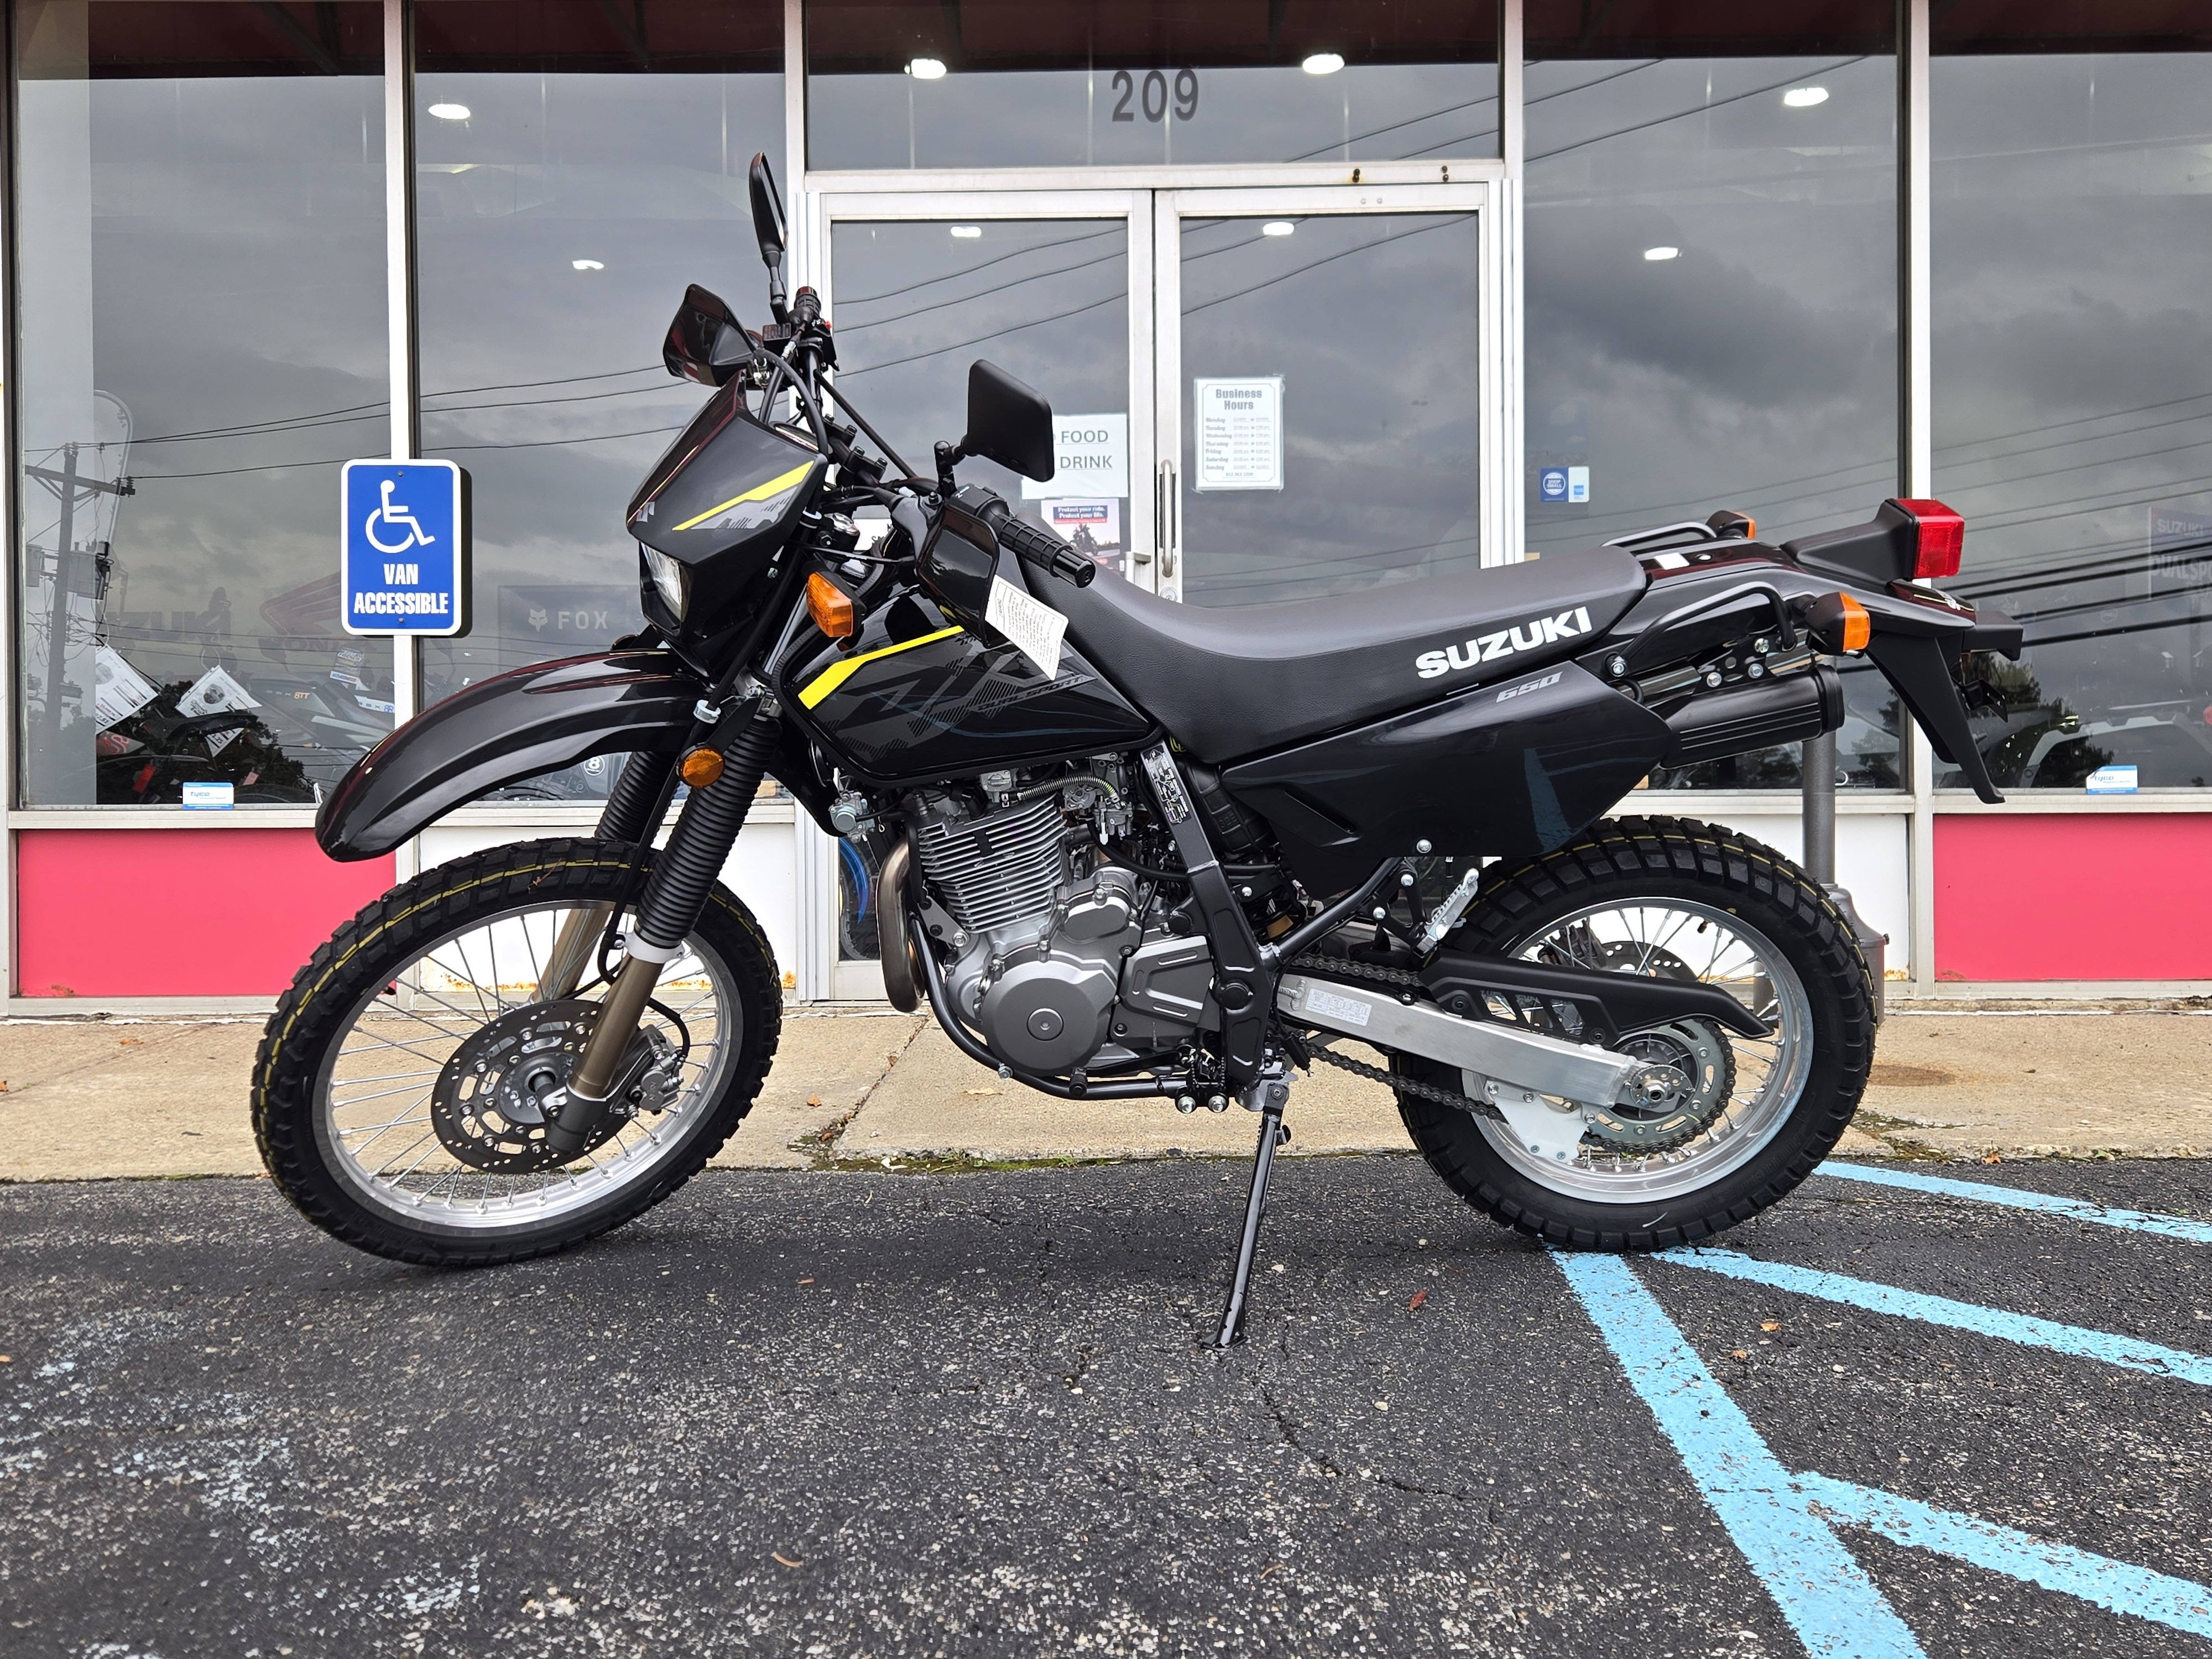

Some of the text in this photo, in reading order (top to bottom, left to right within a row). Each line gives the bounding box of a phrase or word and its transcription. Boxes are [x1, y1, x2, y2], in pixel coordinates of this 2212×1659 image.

[1112, 69, 1198, 123] 209
[1215, 389, 1262, 399] Business
[1224, 400, 1254, 410] Hours
[1061, 430, 1109, 444] FOOD
[1060, 455, 1113, 469] DRINK
[2157, 518, 2204, 534] SUZUKI
[383, 564, 419, 585] VAN
[353, 592, 448, 614] ACCESSIBLE
[558, 611, 608, 629] FOX
[1416, 606, 1593, 679] SUZUKI
[1495, 671, 1563, 703] 650
